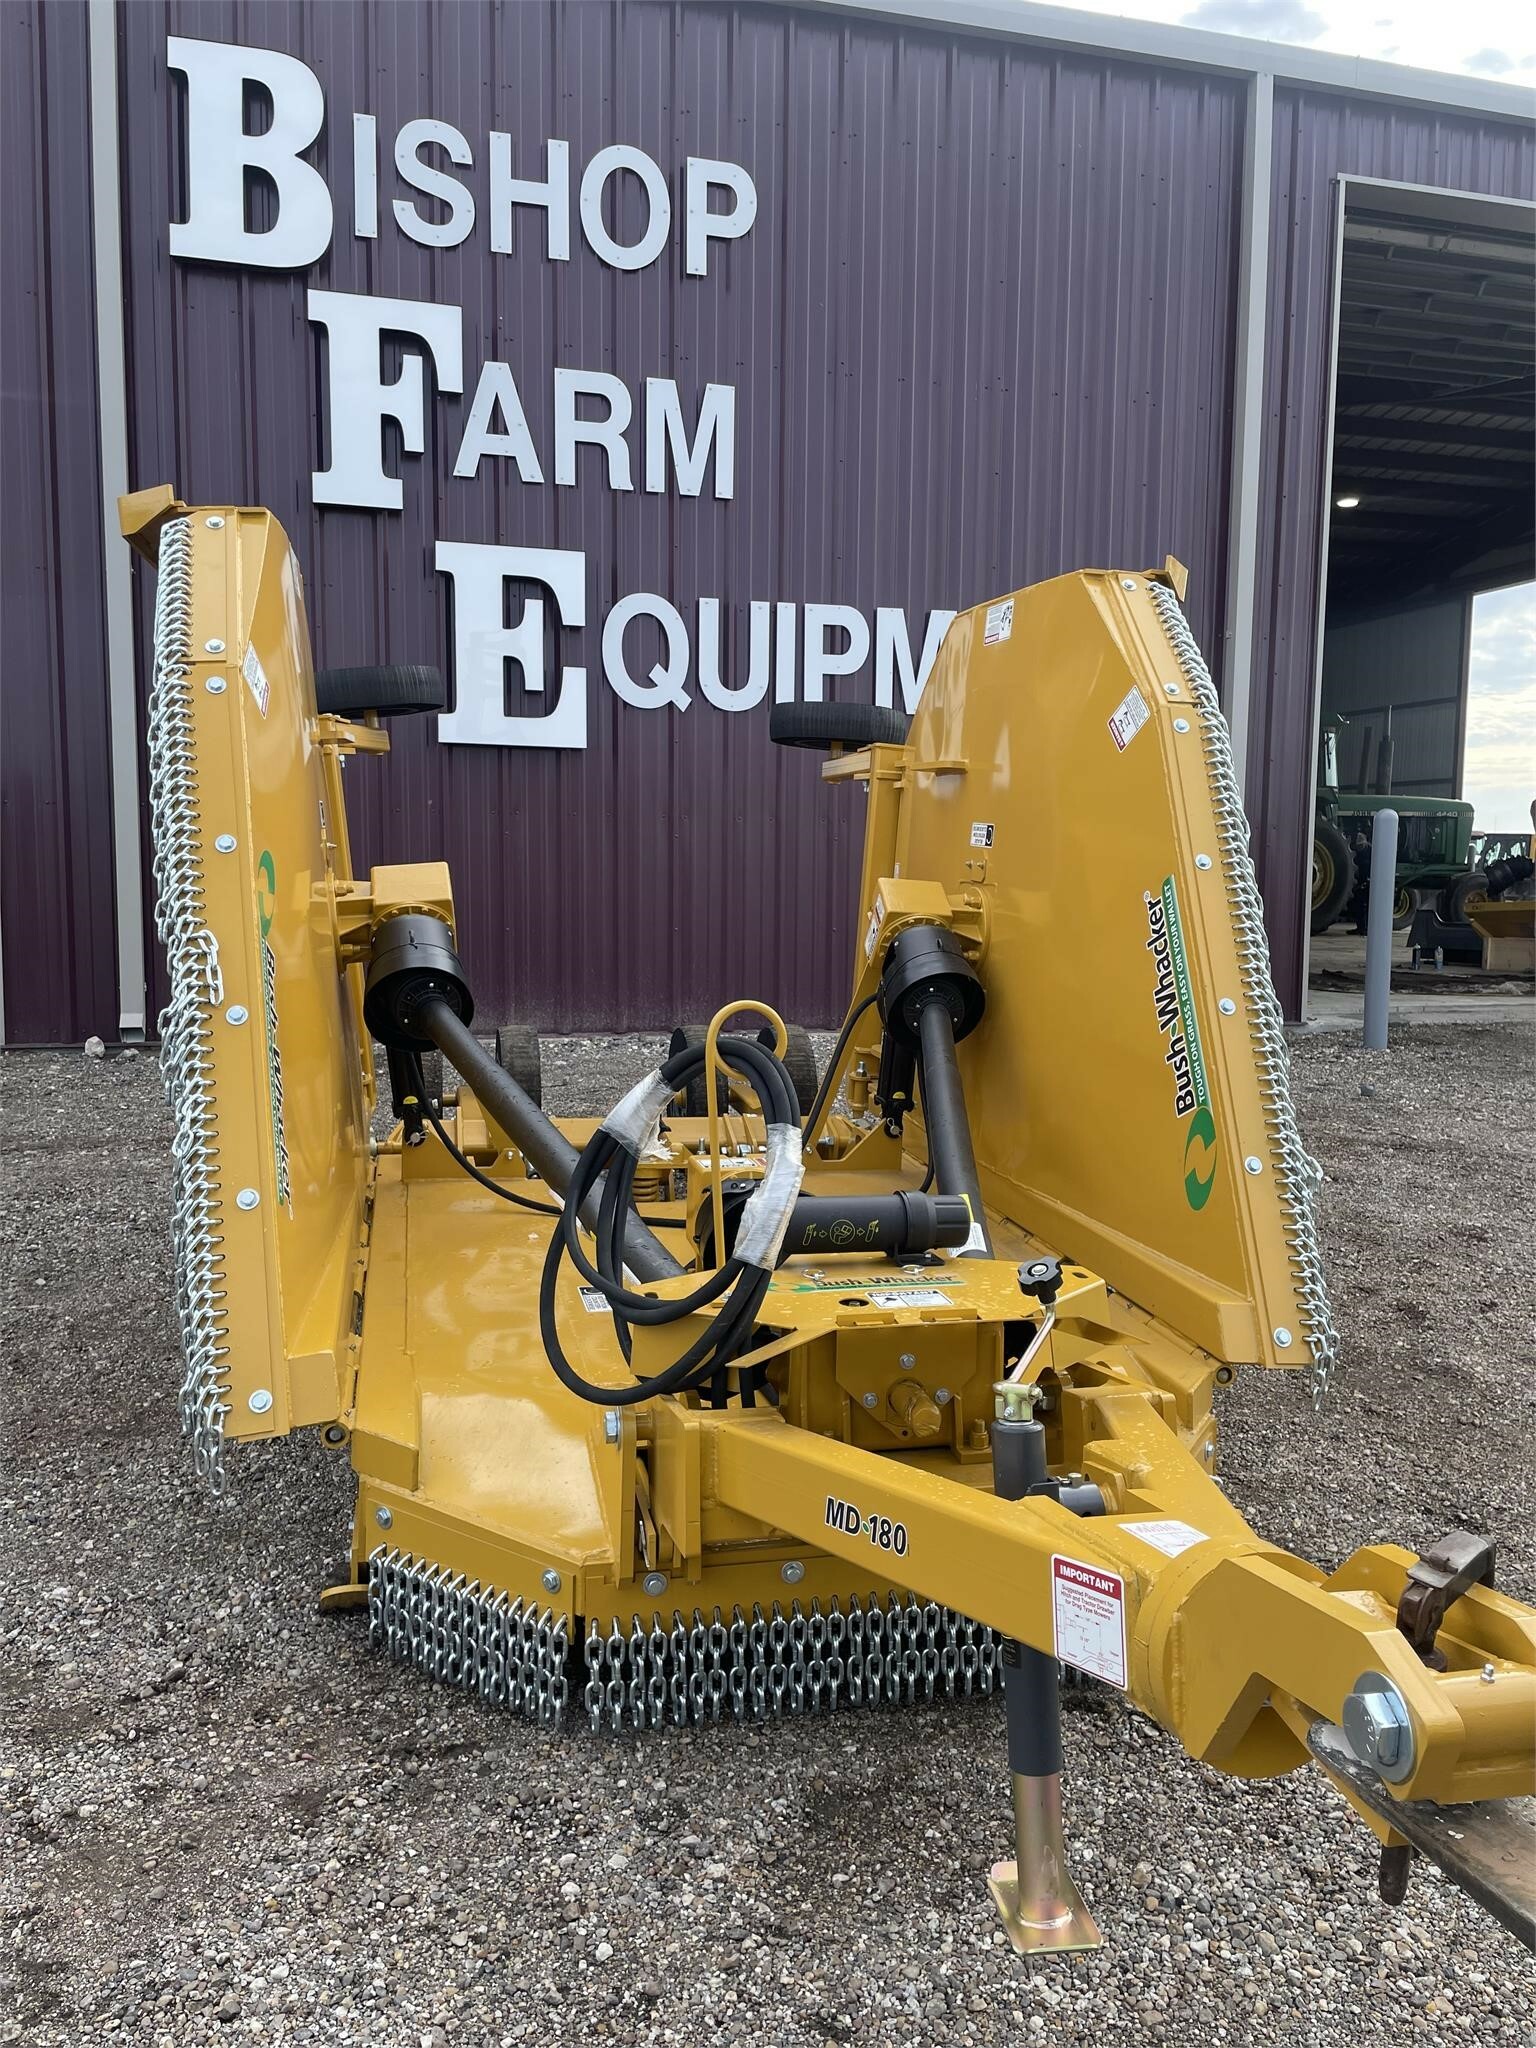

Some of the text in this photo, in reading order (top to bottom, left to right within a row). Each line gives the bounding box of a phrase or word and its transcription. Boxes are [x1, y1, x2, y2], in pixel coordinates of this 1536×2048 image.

[167, 36, 758, 276] BISHOP
[307, 288, 736, 510] FARM
[1163, 884, 1176, 925] WALLET
[1170, 924, 1181, 956] YOUR
[1174, 955, 1184, 972] ON
[1178, 974, 1189, 1002] EASY
[1189, 1043, 1199, 1060] ON
[1193, 1061, 1206, 1104] TOUGH
[825, 1496, 907, 1556] MD-180
[1059, 1564, 1115, 1593] IMPORTANT
[1061, 1583, 1084, 1597] Suggested
[1084, 1592, 1107, 1605] Placement
[1072, 1595, 1081, 1603] and
[1072, 1600, 1082, 1611] Drag
[1082, 1604, 1093, 1614] Type
